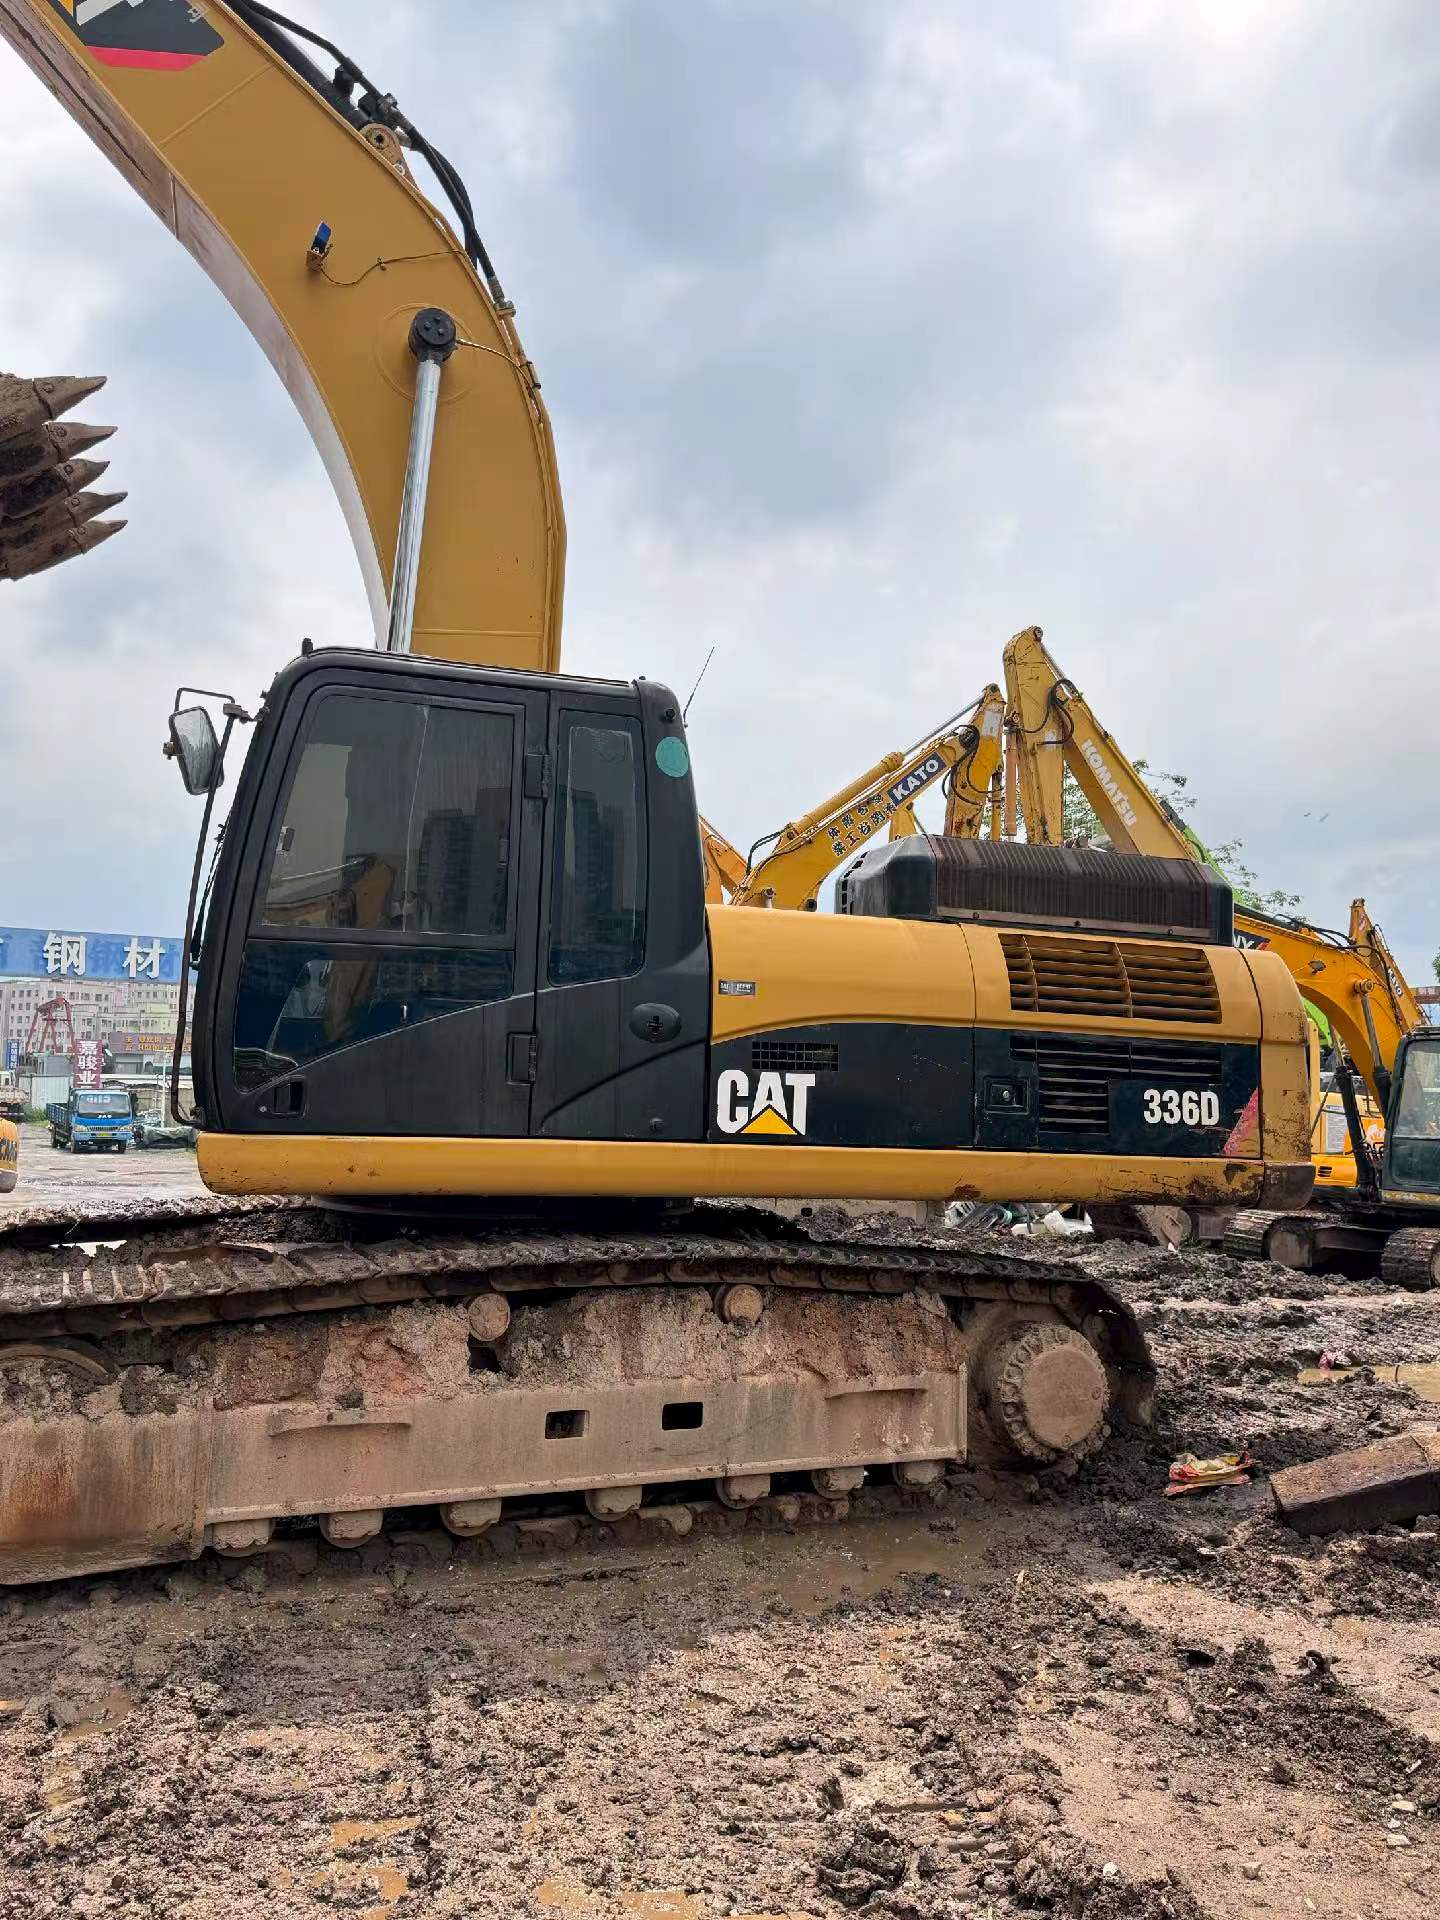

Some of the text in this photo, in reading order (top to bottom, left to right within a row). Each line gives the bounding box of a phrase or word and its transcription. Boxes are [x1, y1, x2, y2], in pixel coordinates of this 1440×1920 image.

[892, 759, 939, 800] KATO
[1081, 739, 1136, 826] KOMATSU
[43, 932, 166, 979] 钢材
[716, 1069, 816, 1136] CAT
[1143, 1085, 1220, 1126] 336D
